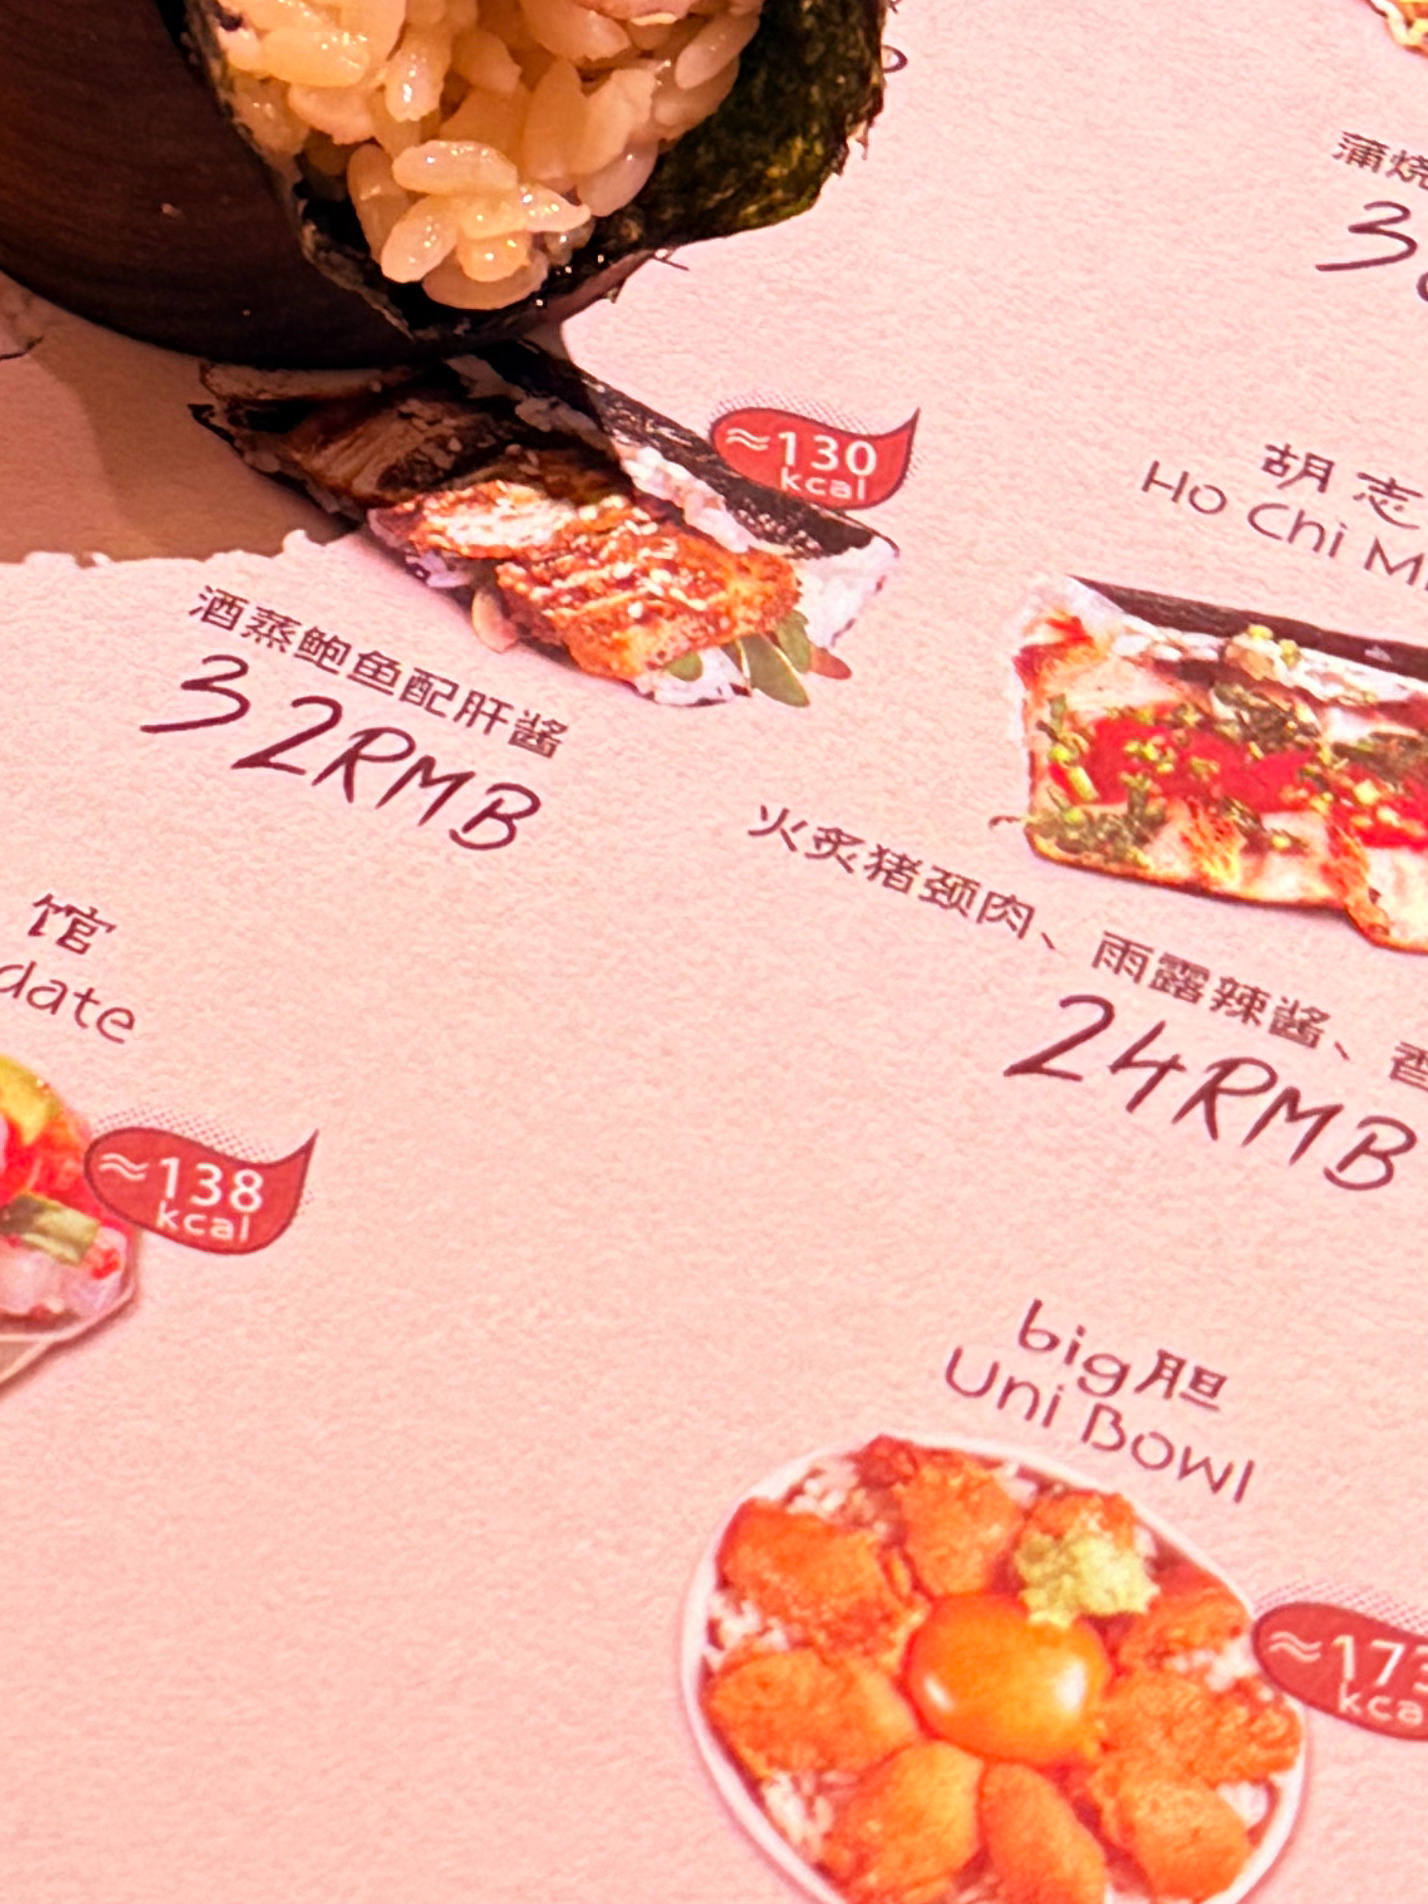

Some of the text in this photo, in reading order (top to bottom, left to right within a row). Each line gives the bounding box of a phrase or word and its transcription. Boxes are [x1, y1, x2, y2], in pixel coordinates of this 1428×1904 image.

[1314, 199, 1428, 303] 3
[781, 470, 867, 502] kcal
[1141, 460, 1428, 592] Ho Chi M
[1262, 444, 1426, 530] 胡志
[187, 584, 569, 760] 酒蒸鲍鱼配肝酱
[140, 653, 541, 852] 32RMB
[1004, 992, 1421, 1193] 24RMB
[156, 1205, 248, 1244] kcal
[1017, 1298, 1228, 1412] big胆
[945, 1347, 1255, 1505] Uni Bowl
